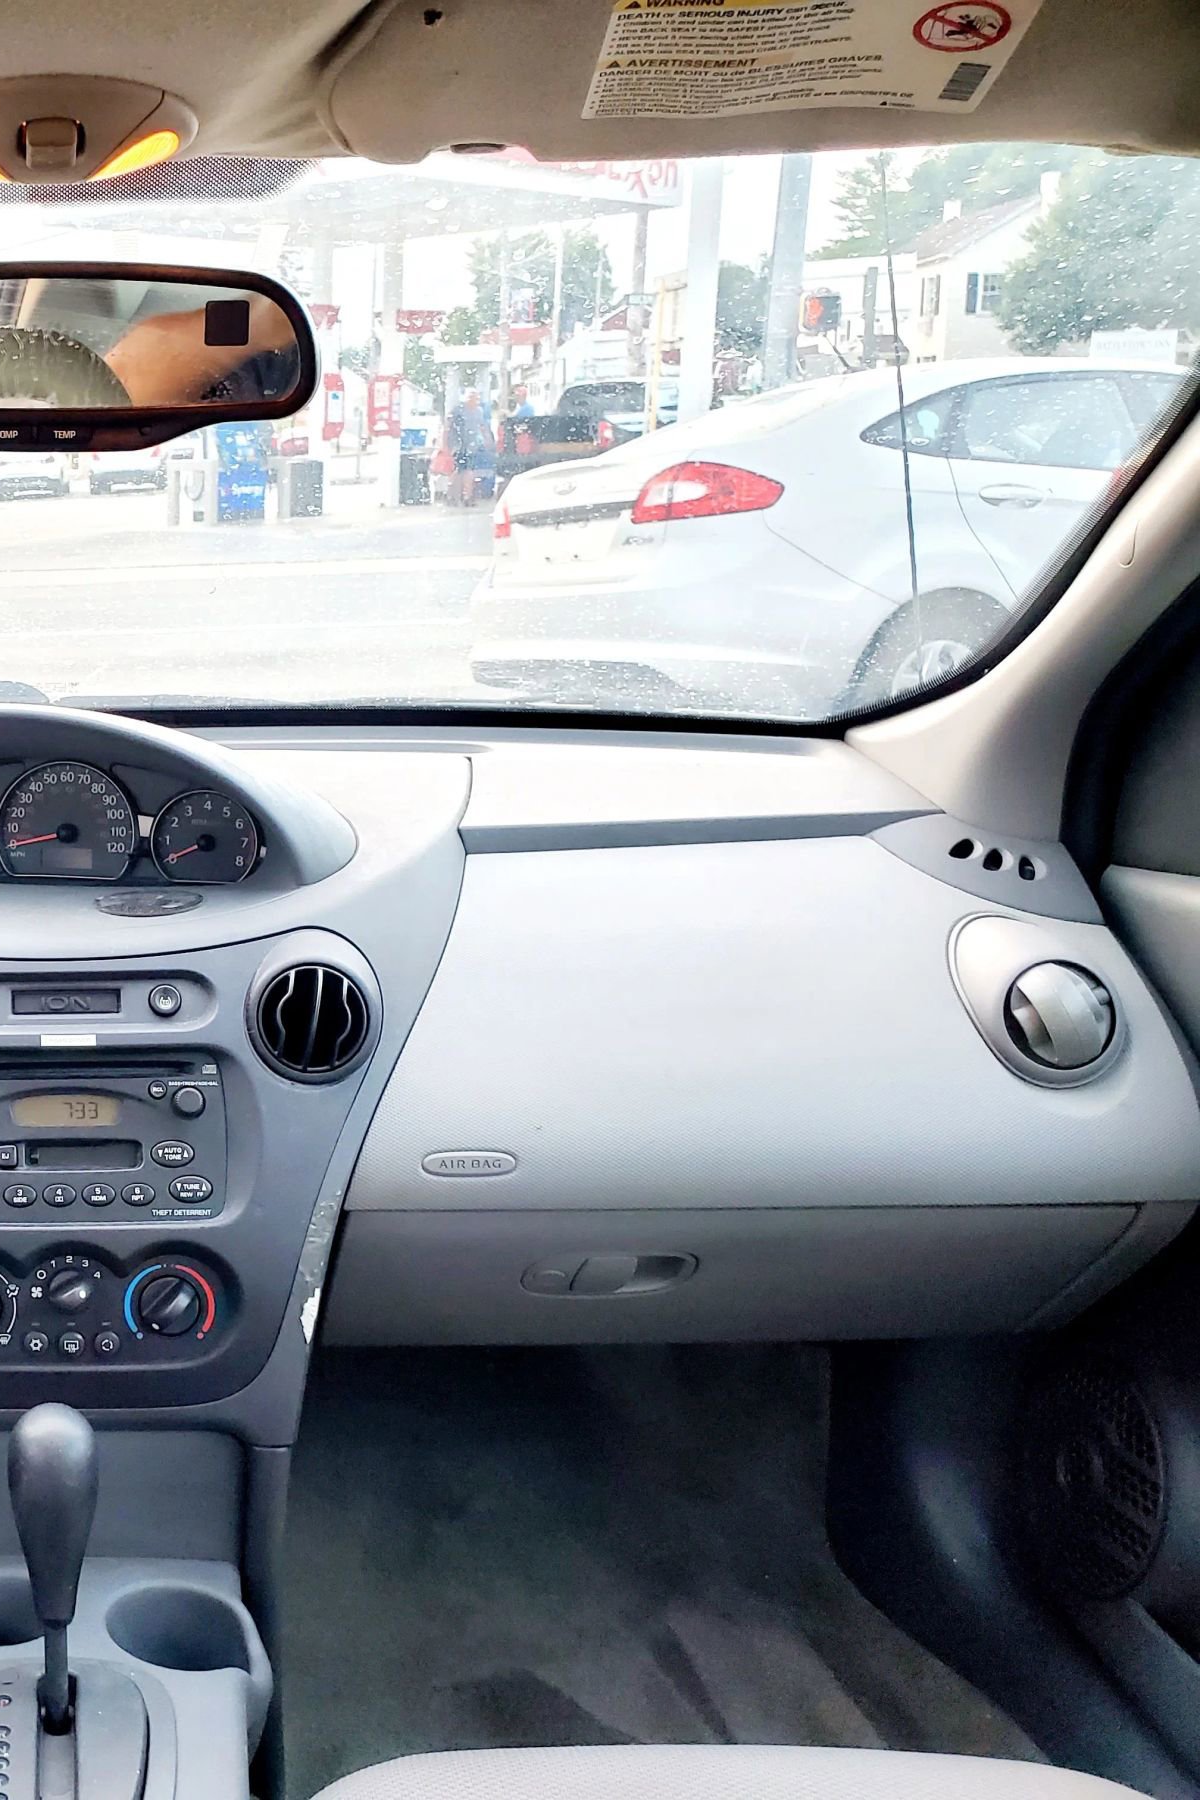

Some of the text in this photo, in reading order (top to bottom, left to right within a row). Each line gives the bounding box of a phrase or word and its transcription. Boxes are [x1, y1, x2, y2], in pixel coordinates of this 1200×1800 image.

[617, 12, 660, 21] DEATH
[677, 10, 735, 18] SERIOUS
[737, 8, 785, 17] INJURY
[785, 6, 807, 14] can
[599, 69, 652, 78] DANGER
[748, 58, 824, 75] BLESSURES
[626, 58, 758, 68] AVERTISSEMENT
[53, 430, 77, 439] TEMP
[43, 775, 57, 784] 50
[60, 772, 74, 782] 60
[78, 774, 91, 784] 70
[29, 782, 43, 792] 40
[91, 783, 106, 794] 80
[19, 794, 33, 804] 30
[102, 795, 116, 805] 90
[204, 800, 212, 811] 4
[11, 807, 25, 817] 20
[106, 809, 125, 819] 100
[184, 806, 192, 816] 3
[223, 806, 231, 817] 5
[171, 817, 179, 828] 2
[235, 818, 244, 829] 6
[7, 823, 19, 833] 10
[111, 827, 126, 836] 110
[165, 835, 170, 845] 1
[240, 837, 249, 848] 7
[107, 842, 125, 853] 120
[235, 856, 244, 866] 8
[40, 996, 92, 1011] ION
[439, 1159, 502, 1169] AIR BAG
[50, 1260, 56, 1268] 1
[65, 1255, 73, 1263] 2
[82, 1259, 89, 1267] 3
[93, 1271, 101, 1279] 4
